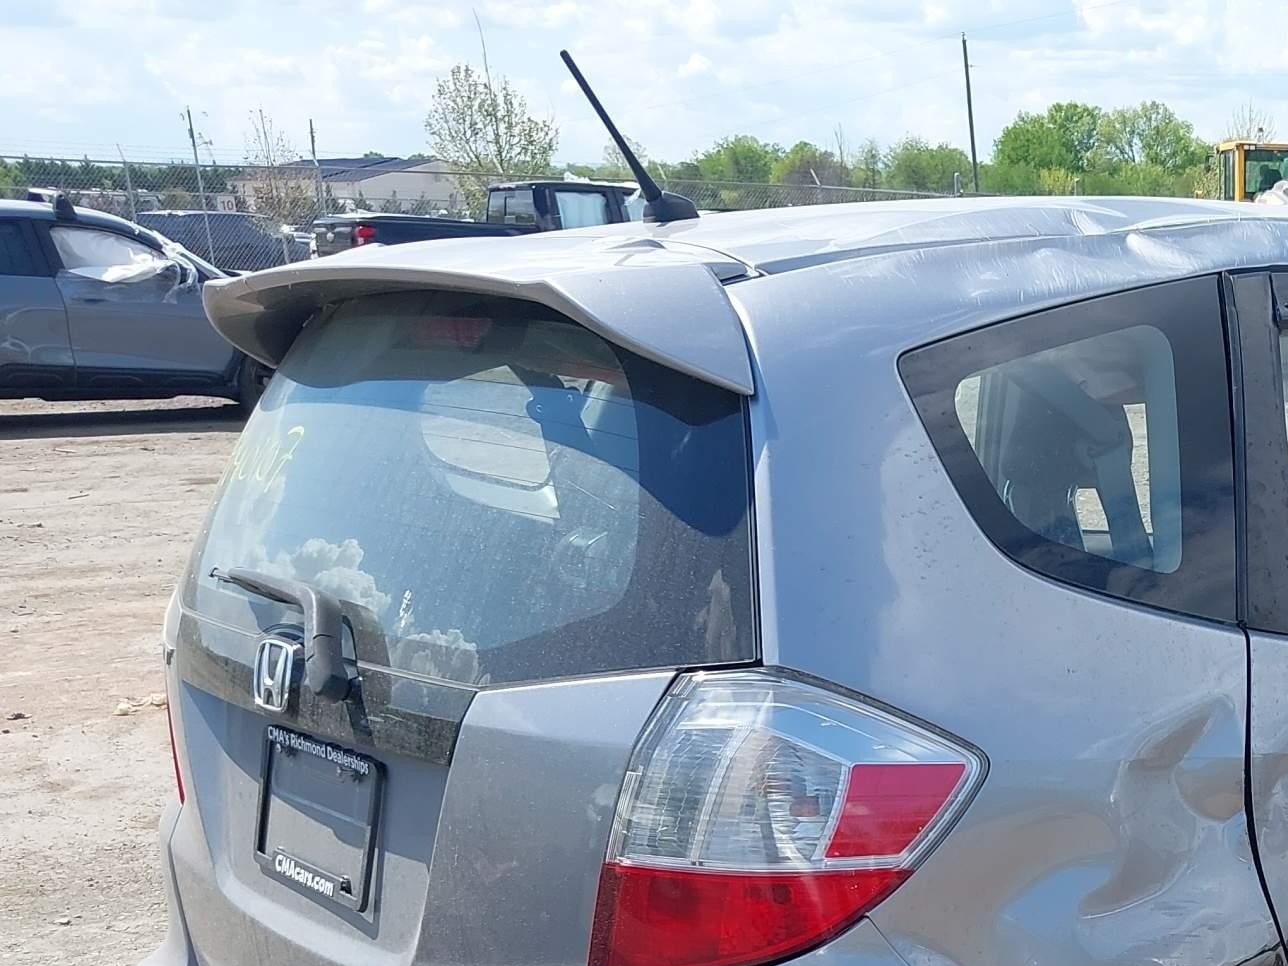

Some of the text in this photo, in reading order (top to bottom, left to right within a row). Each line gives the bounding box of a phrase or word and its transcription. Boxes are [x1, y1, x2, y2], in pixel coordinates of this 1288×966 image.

[220, 199, 234, 211] 10
[290, 732, 326, 759] Richmond
[326, 744, 370, 776] Dealerships
[275, 854, 335, 898] CMAcars.com
